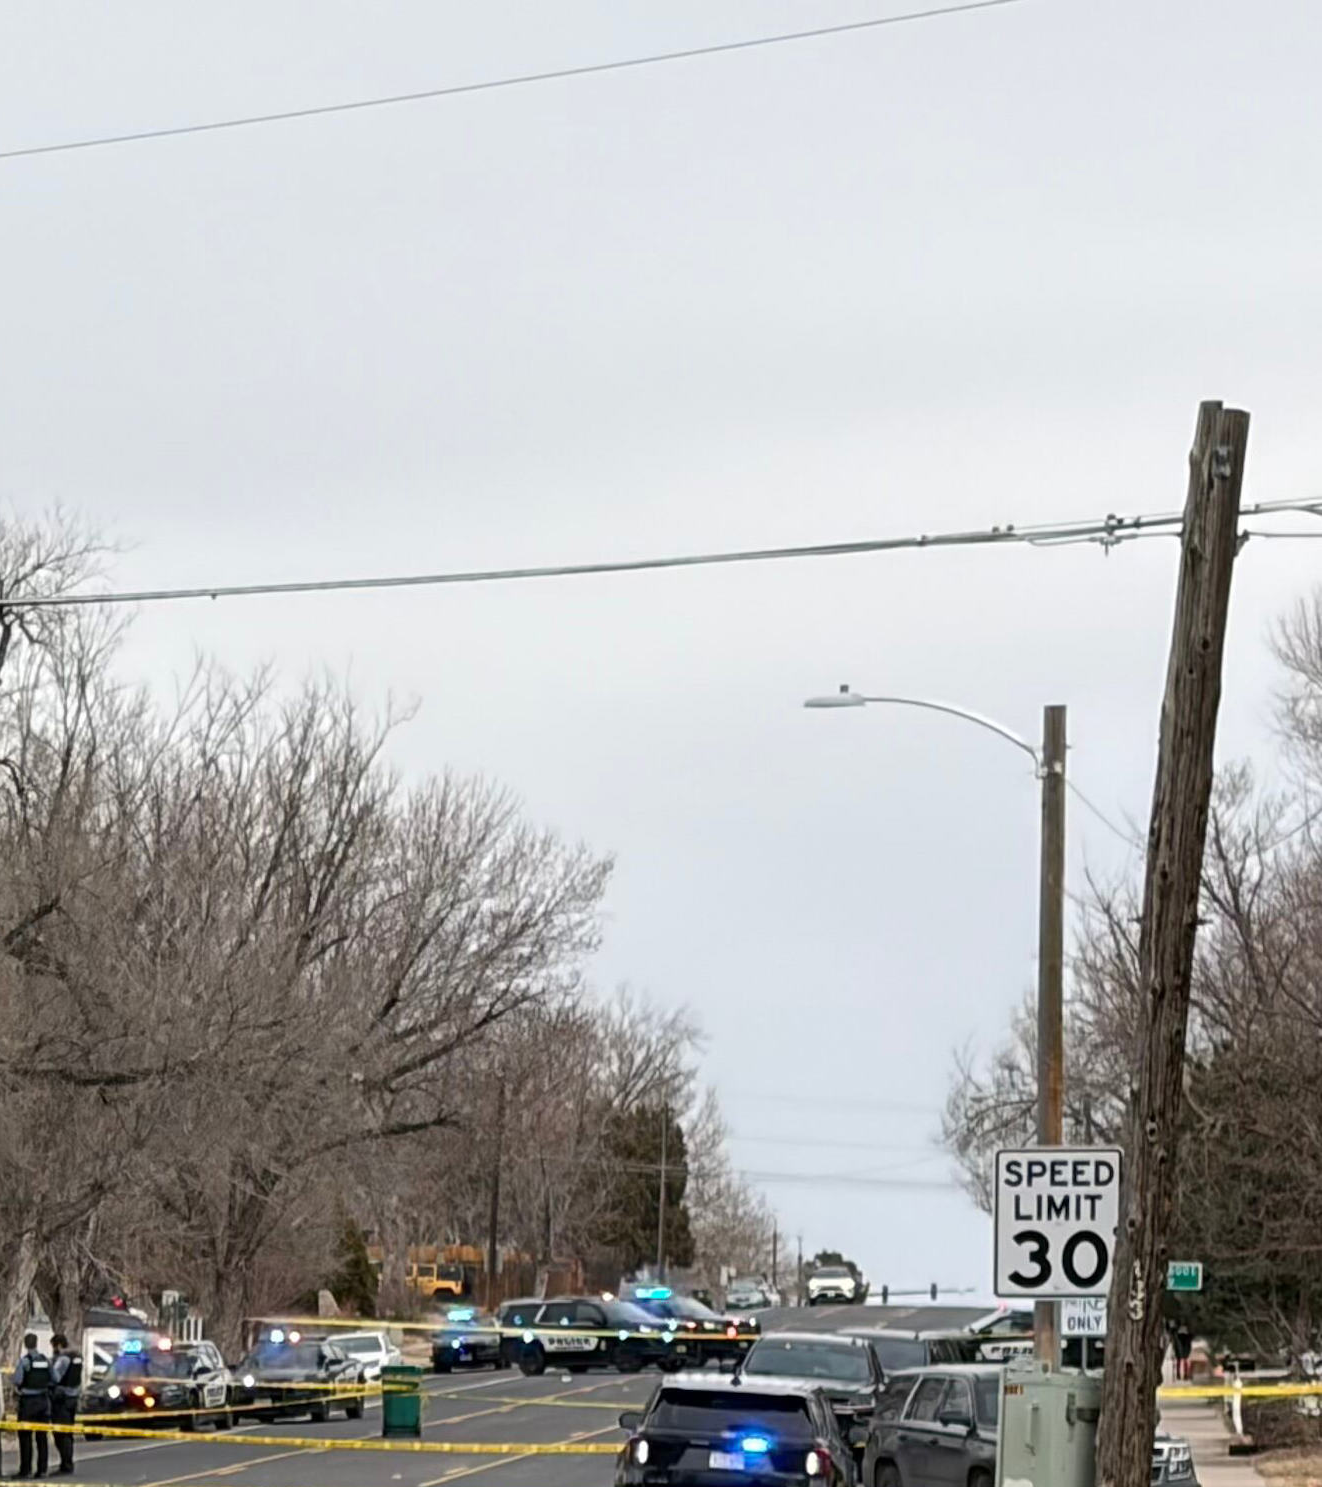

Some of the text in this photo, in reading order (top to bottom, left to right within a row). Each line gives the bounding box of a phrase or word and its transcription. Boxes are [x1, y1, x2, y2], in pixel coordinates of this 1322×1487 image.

[1004, 1160, 1114, 1187] SPEED
[1014, 1194, 1103, 1221] LIMIT
[1007, 1229, 1109, 1289] 30
[1067, 1315, 1102, 1331] ONLY
